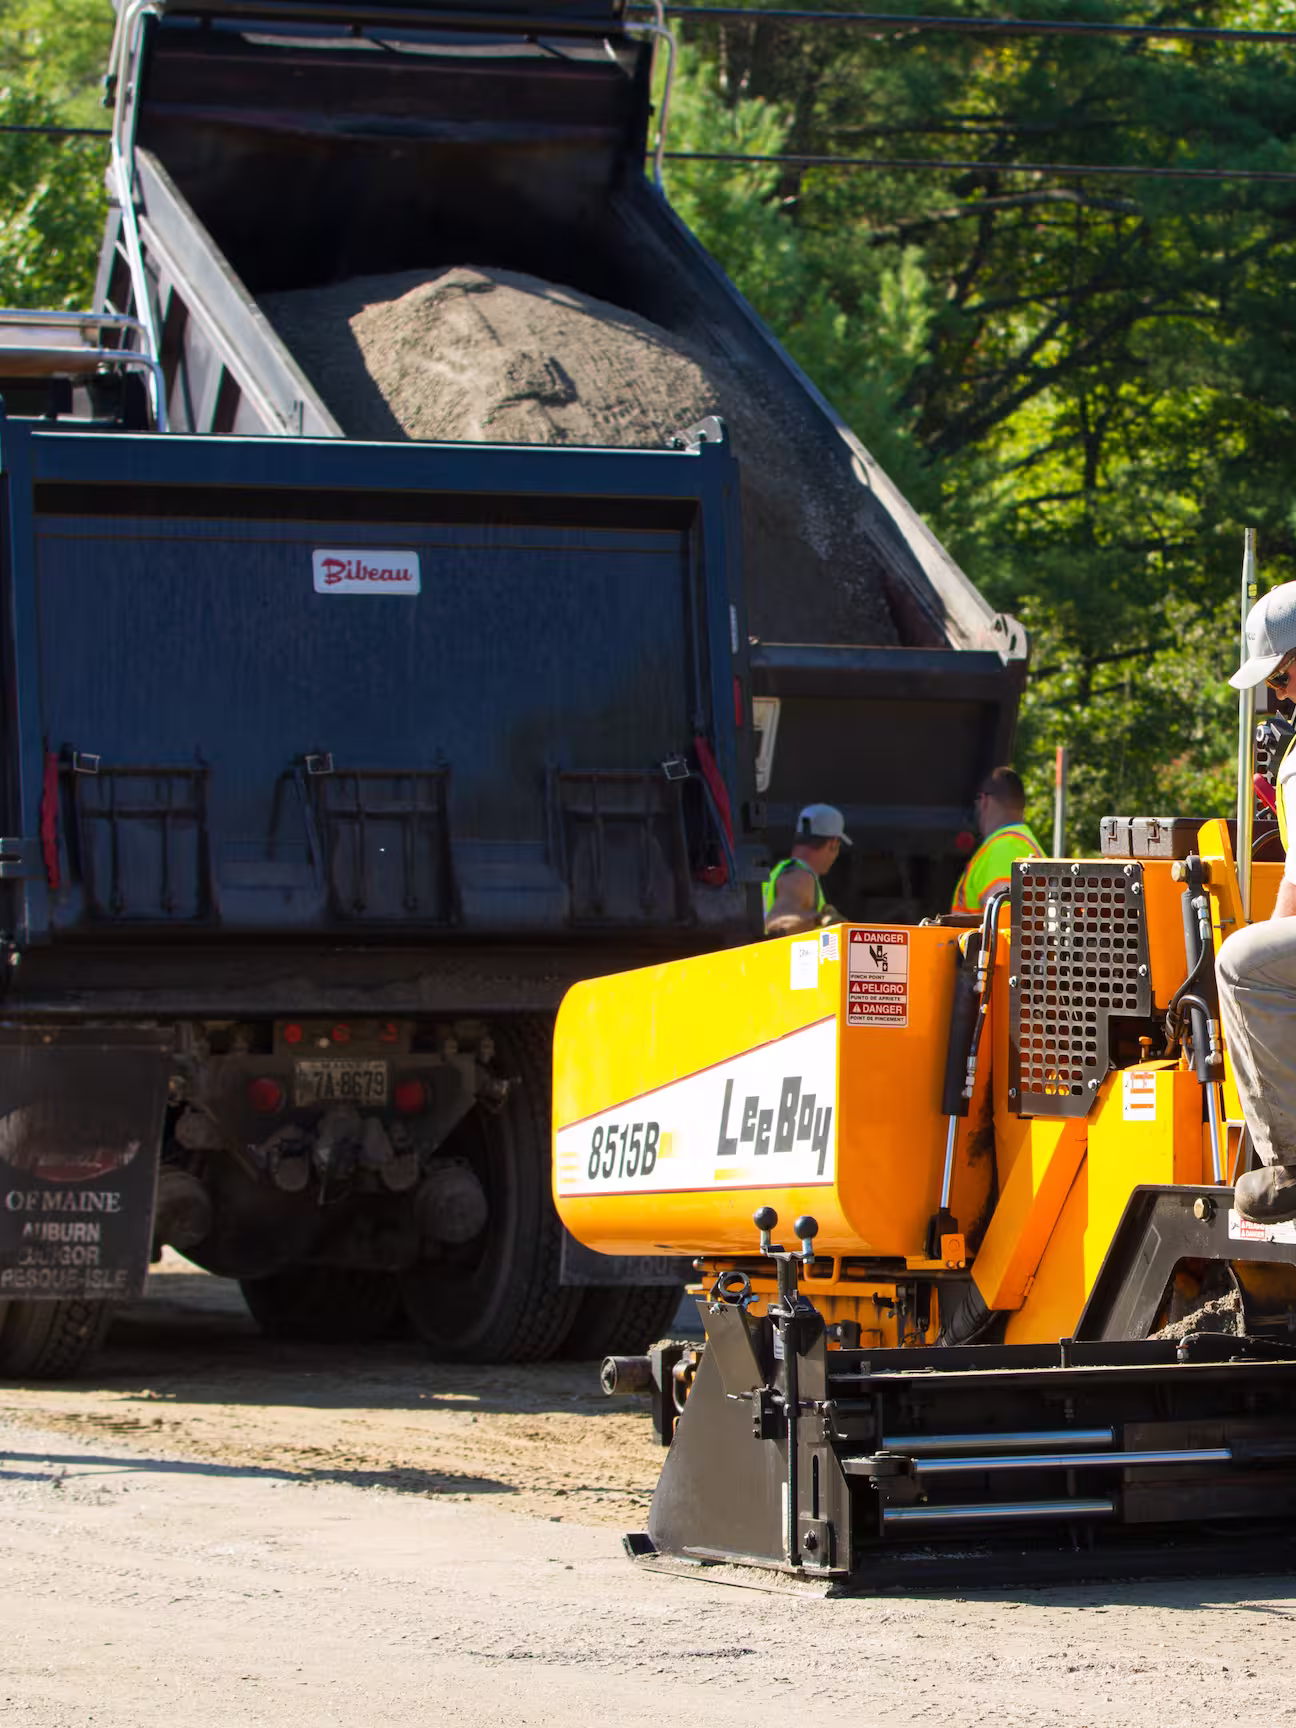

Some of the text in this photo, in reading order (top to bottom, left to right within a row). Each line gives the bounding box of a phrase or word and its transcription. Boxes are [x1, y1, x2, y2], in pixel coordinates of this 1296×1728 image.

[321, 558, 413, 586] Bibeau
[864, 933, 904, 943] DANGER
[862, 984, 904, 994] PELIGRO
[863, 1004, 903, 1014] DANGER
[716, 1076, 833, 1176] LeeBoy
[588, 1121, 660, 1180] 8515B
[6, 1191, 121, 1213] OF MAINE
